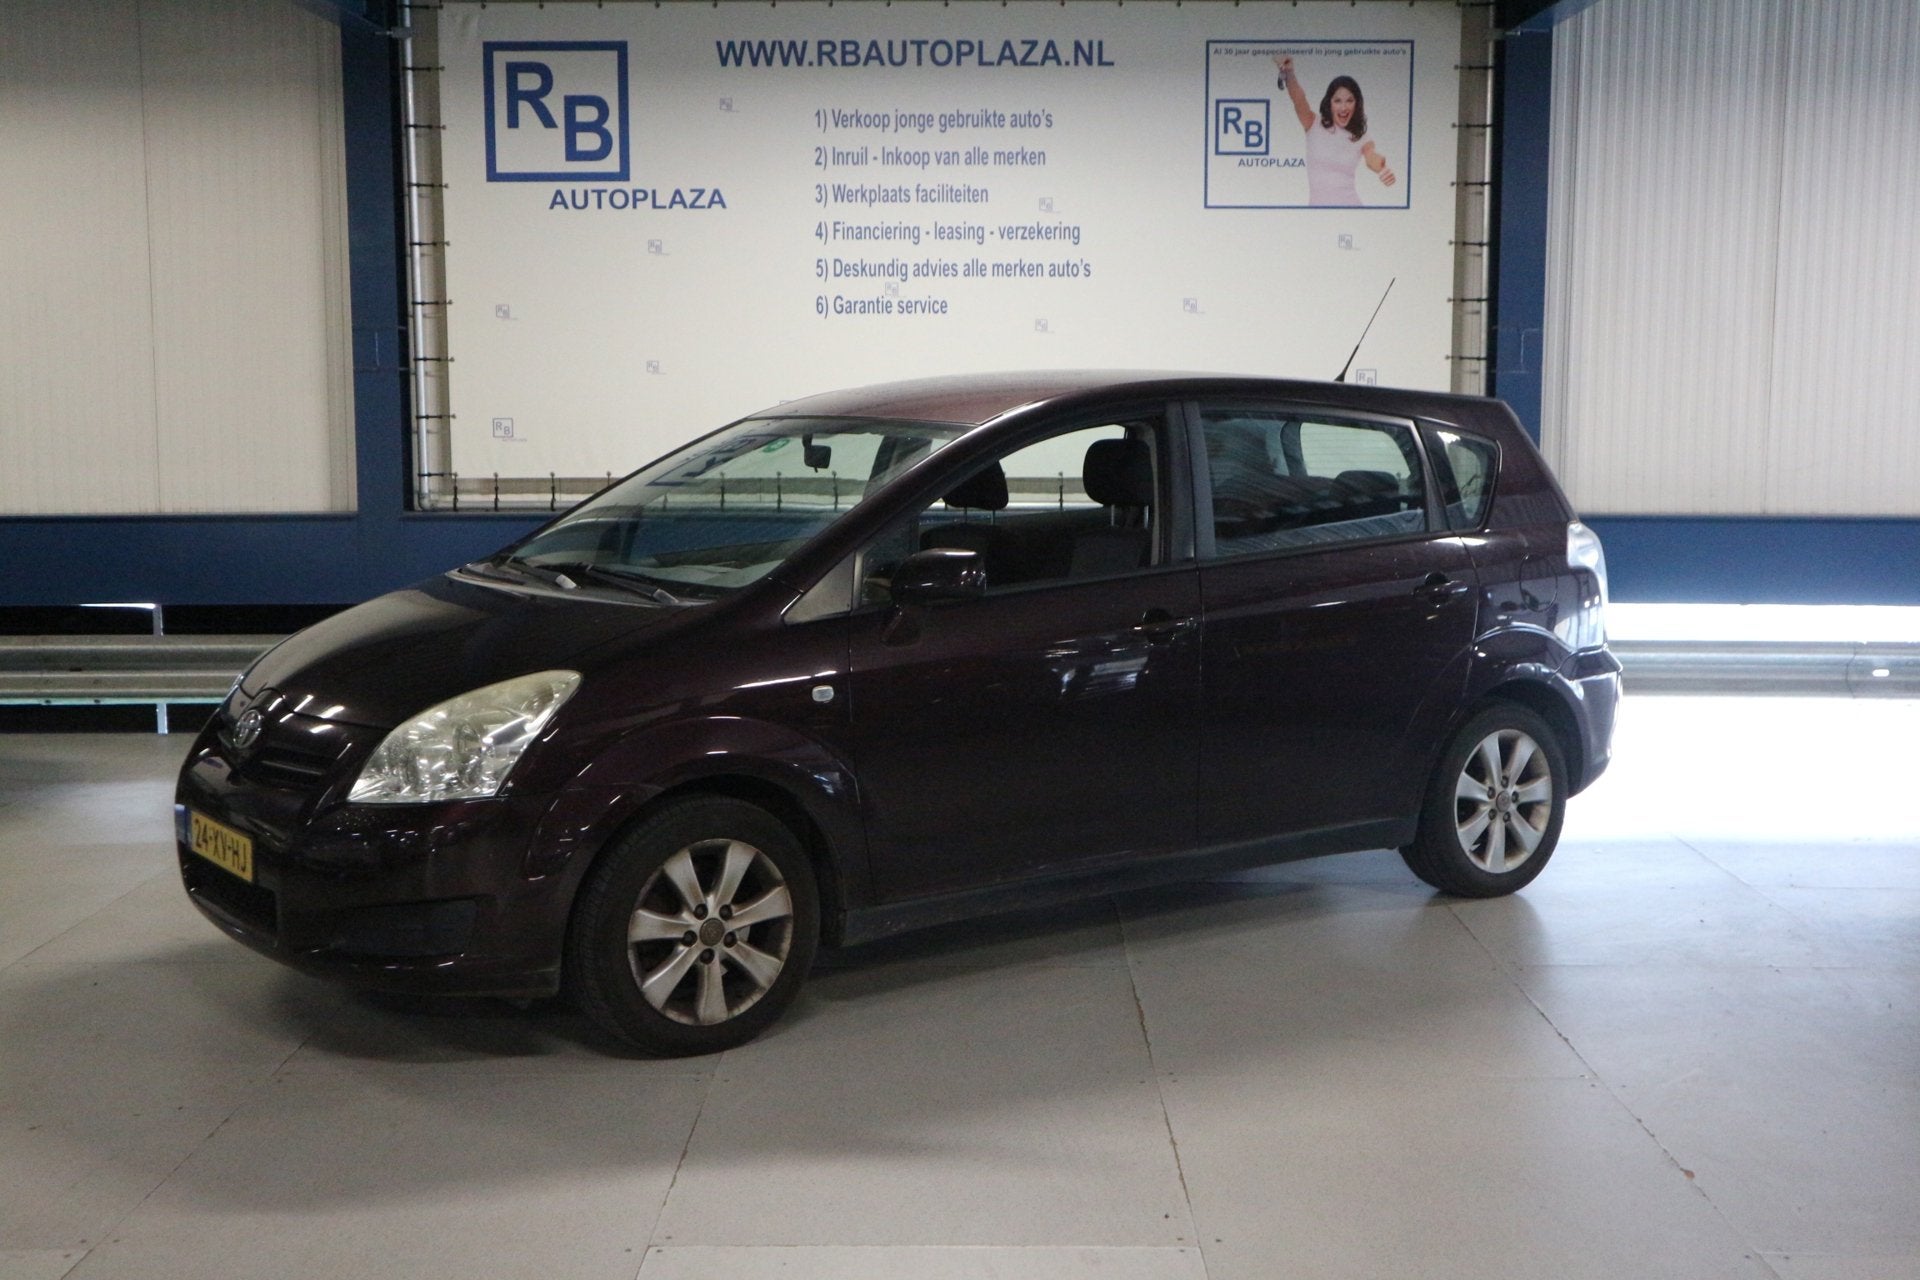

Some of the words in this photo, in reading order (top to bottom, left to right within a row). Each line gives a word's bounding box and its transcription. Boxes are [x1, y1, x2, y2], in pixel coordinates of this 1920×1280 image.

[716, 40, 1115, 68] WWW.RBAUTOPLAZA.NL
[814, 109, 828, 133] 1)
[831, 109, 890, 132] Verkoop
[893, 109, 934, 133] jonge
[938, 109, 1006, 134] gebruikte
[1010, 109, 1053, 129] auto's
[814, 146, 828, 170] 2)
[832, 146, 868, 166] Inruil
[881, 146, 930, 169] Inkoop
[934, 150, 960, 166] van
[964, 146, 989, 166] alle
[993, 146, 1046, 166] merken
[1238, 158, 1306, 168] AUTOPLAZA
[549, 189, 727, 210] AUTOPLAZA
[815, 184, 828, 208] 3)
[832, 184, 911, 207] Werkplaats
[915, 184, 989, 203] faciliteiten
[815, 221, 829, 246] 4)
[832, 221, 921, 246] Financiering
[934, 221, 985, 246] leasing
[998, 222, 1081, 246] verzekering
[815, 259, 829, 283] 5)
[833, 259, 909, 283] Deskundig
[912, 259, 959, 278] advies
[962, 259, 988, 278] alle
[991, 259, 1044, 278] merken
[1048, 259, 1092, 278] auto's
[815, 295, 829, 319] 6)
[833, 295, 893, 315] Garantie
[897, 296, 948, 315] service
